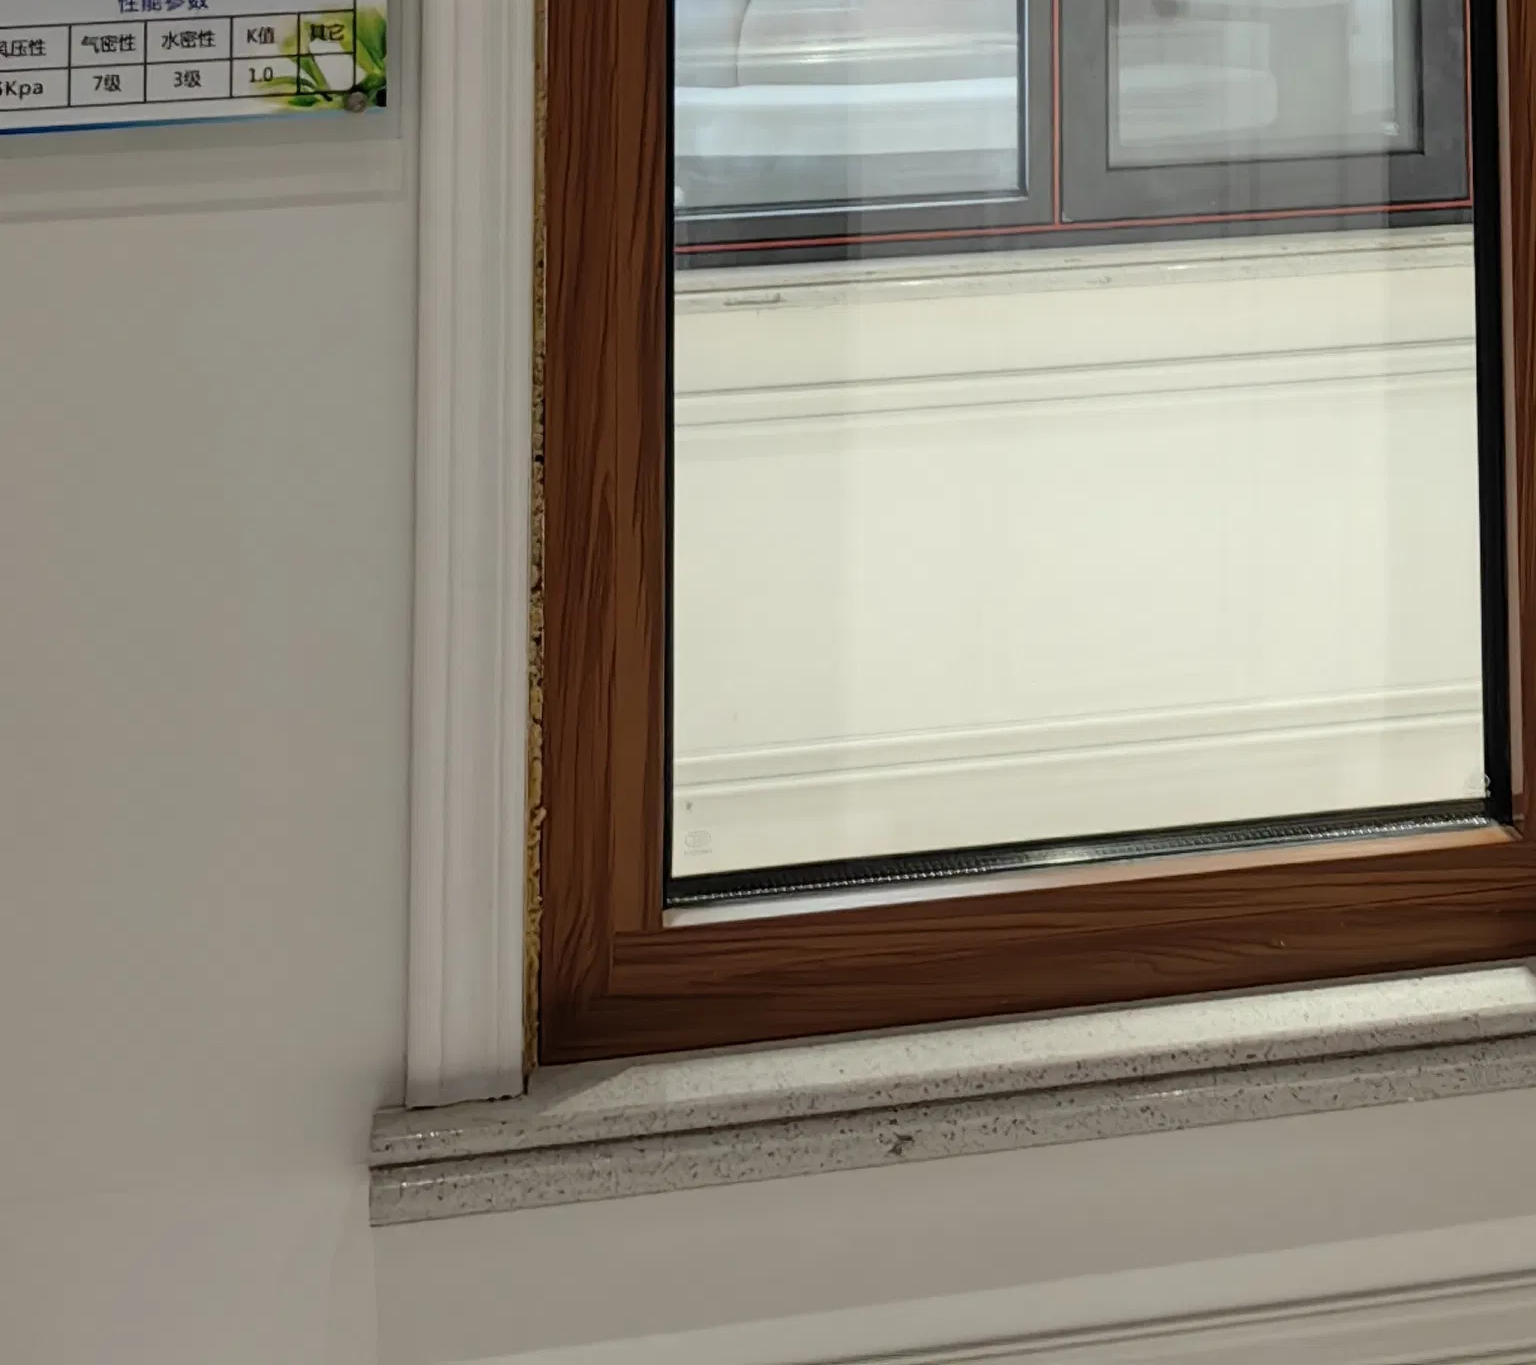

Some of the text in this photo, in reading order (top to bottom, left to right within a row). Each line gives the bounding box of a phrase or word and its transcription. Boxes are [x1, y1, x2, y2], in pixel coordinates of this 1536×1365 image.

[81, 33, 136, 53] 气密性
[161, 29, 216, 49] 水密性
[246, 26, 275, 44] K值
[93, 74, 122, 92] 7级
[174, 69, 202, 88] 3级
[248, 66, 274, 82] 1.0
